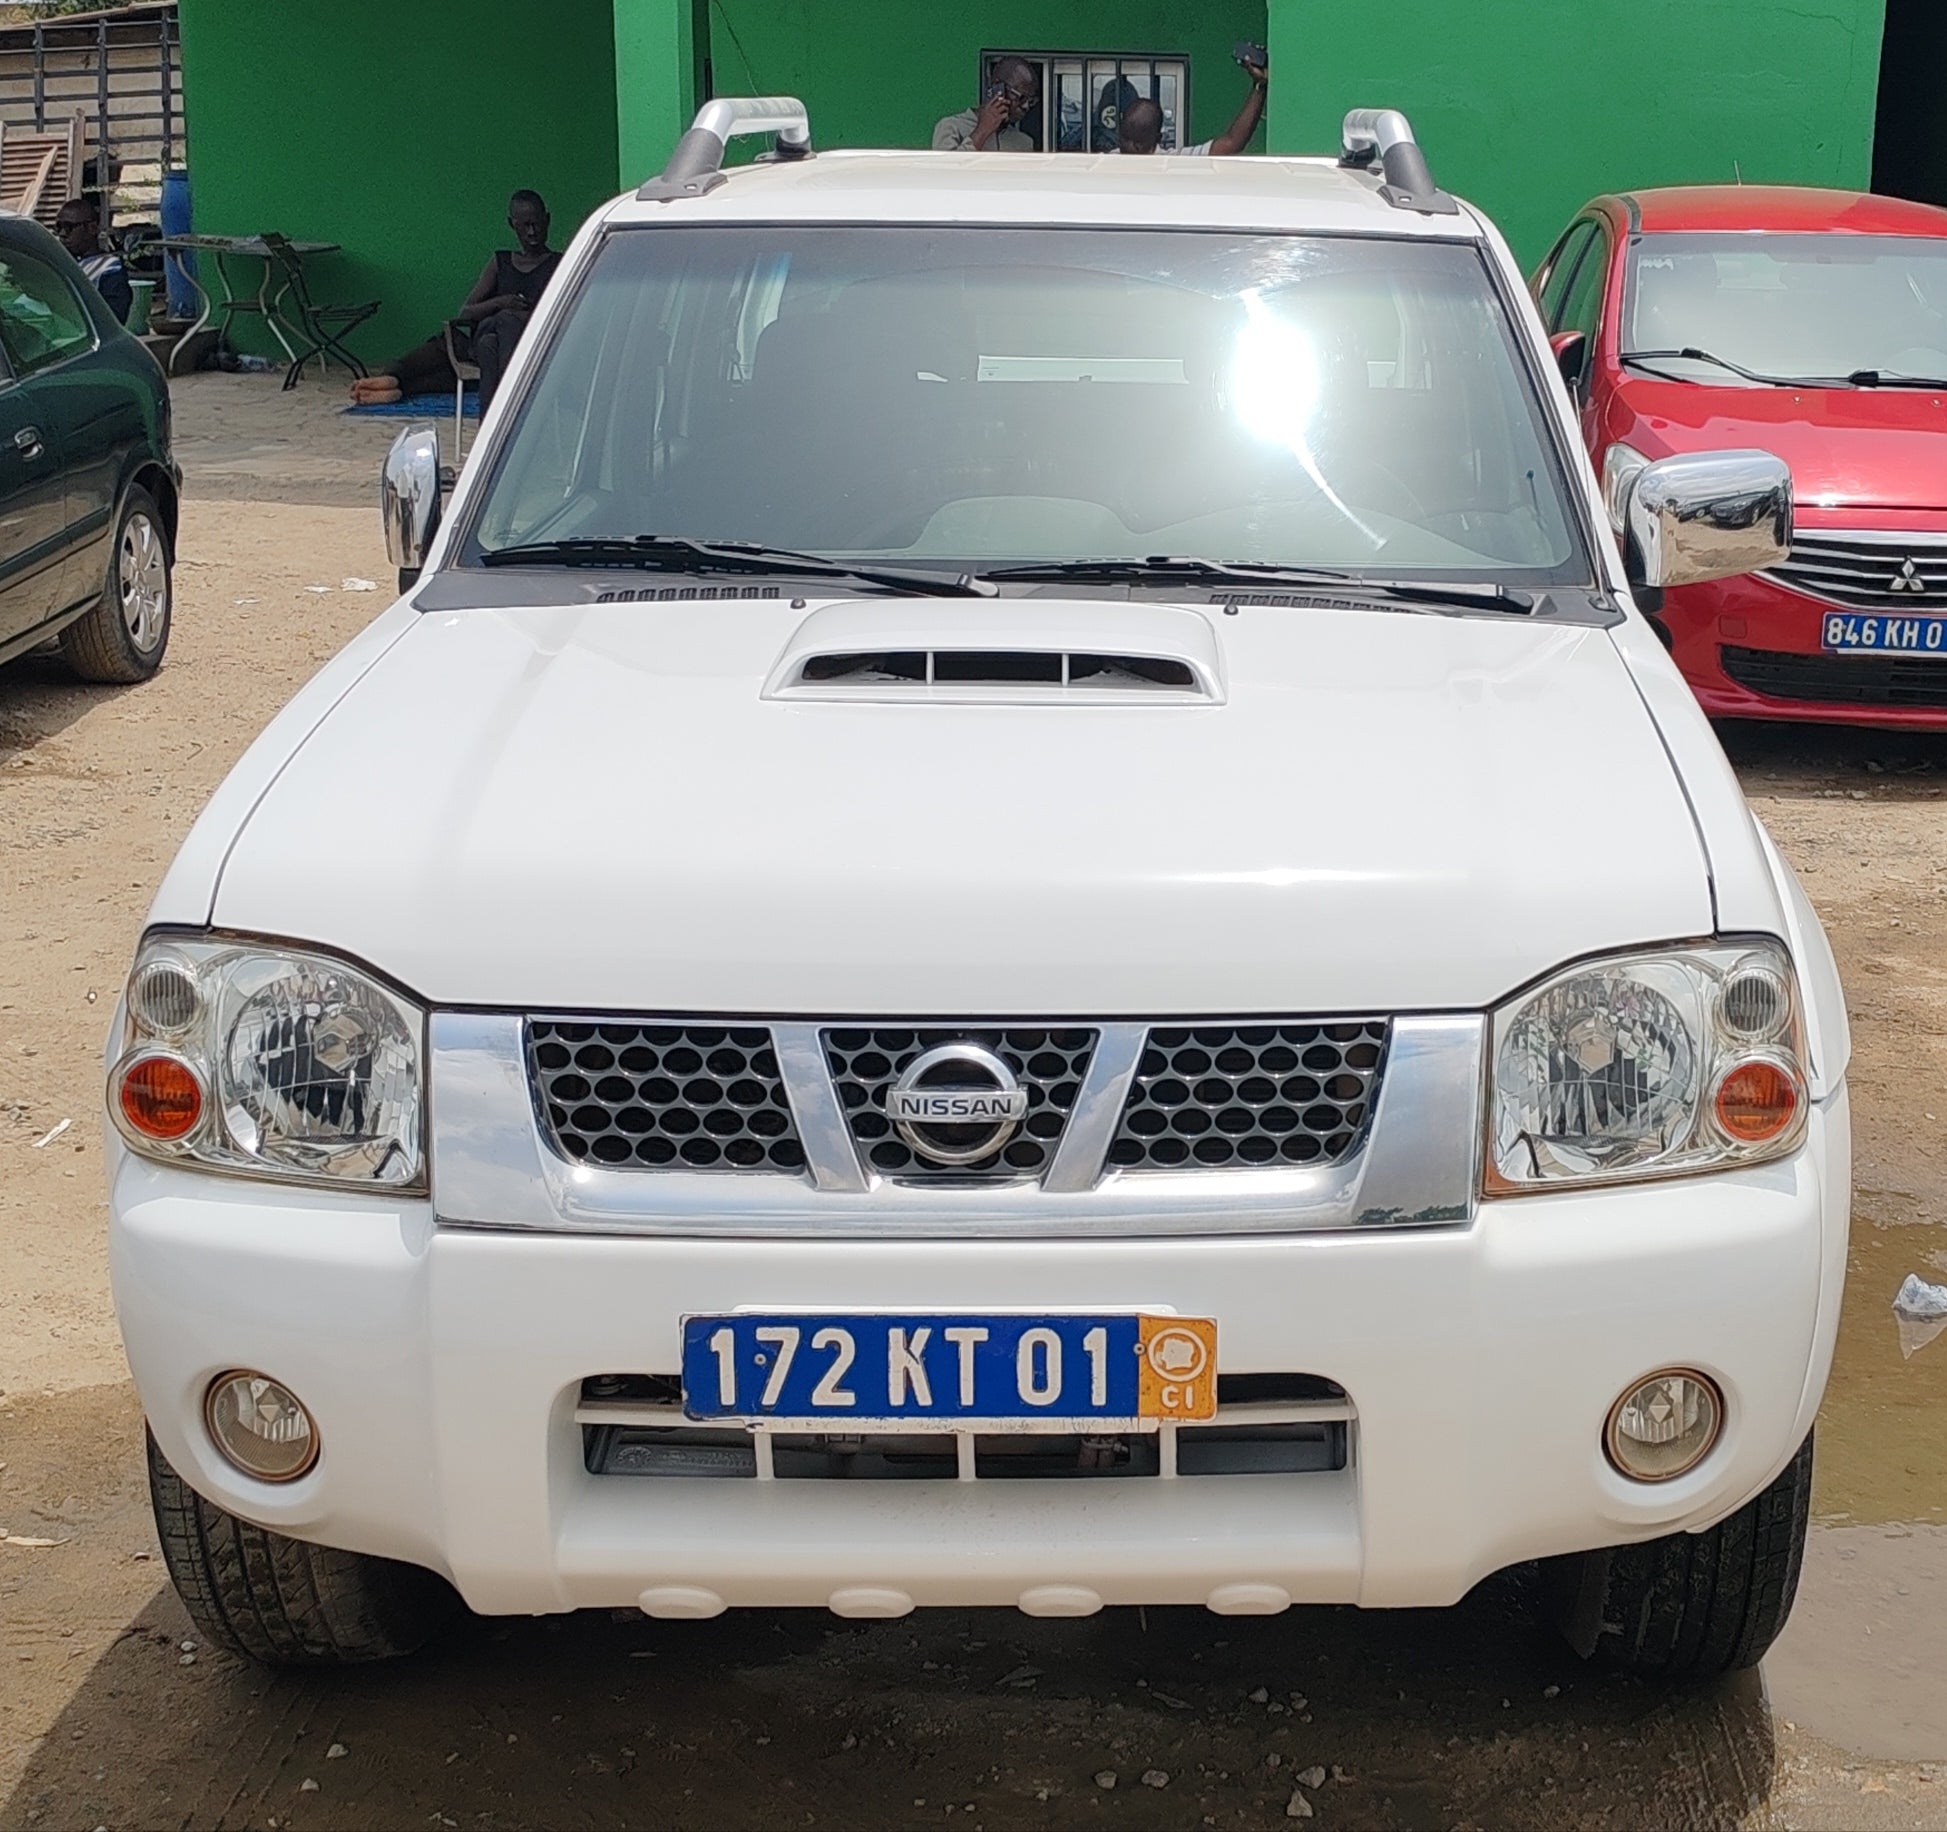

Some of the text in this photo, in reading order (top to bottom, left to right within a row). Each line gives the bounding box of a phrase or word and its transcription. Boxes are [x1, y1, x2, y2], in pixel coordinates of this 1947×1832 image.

[1827, 617, 1878, 645] 846
[1884, 619, 1920, 647] KH
[901, 1098, 1011, 1115] NISSAN
[709, 1327, 1108, 1407] 172 KT 01
[1161, 1384, 1194, 1410] CI
